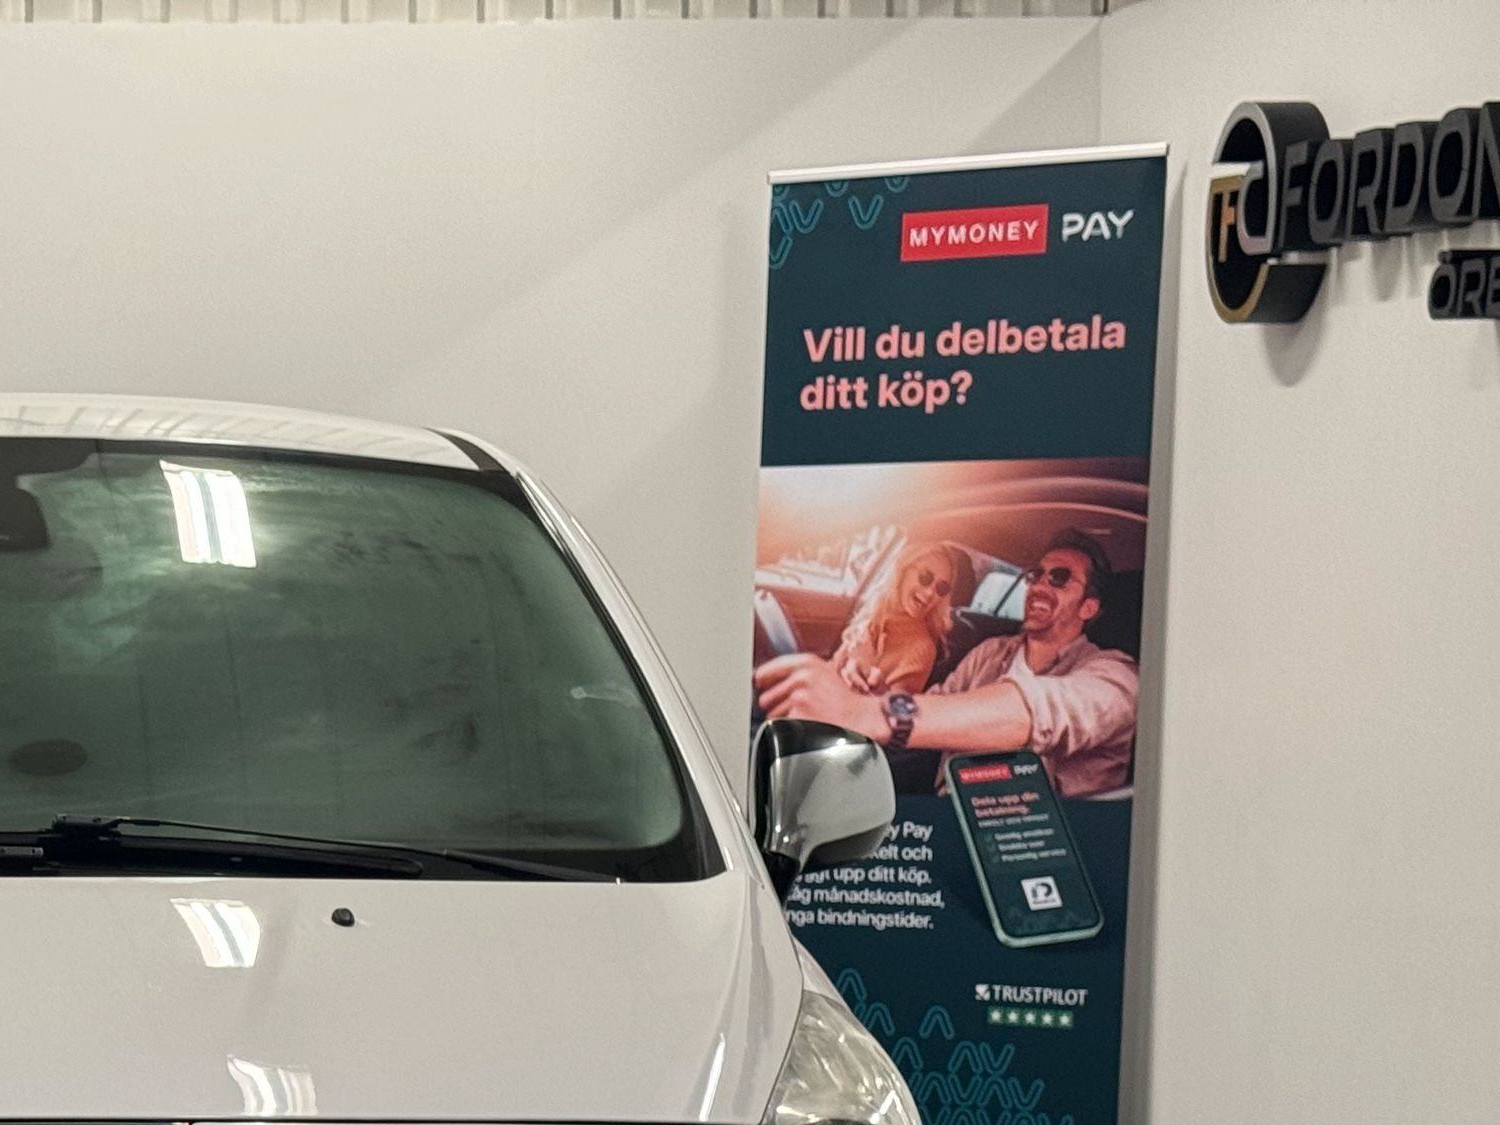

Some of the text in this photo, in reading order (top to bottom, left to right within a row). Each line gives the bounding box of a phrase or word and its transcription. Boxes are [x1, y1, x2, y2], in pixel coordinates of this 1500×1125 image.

[908, 209, 1135, 248] MYMONEY PAY
[803, 313, 1127, 363] Vill du delbetala
[799, 369, 974, 415] ditt köp?
[902, 821, 934, 843] Pay
[901, 845, 933, 861] och
[833, 868, 866, 885] upp
[867, 866, 896, 883] ditt
[898, 867, 932, 886] köp.
[813, 886, 946, 909] månadskostnad,
[816, 908, 935, 931] bindningstider.
[991, 984, 1089, 1007] TRUSTPILOT
